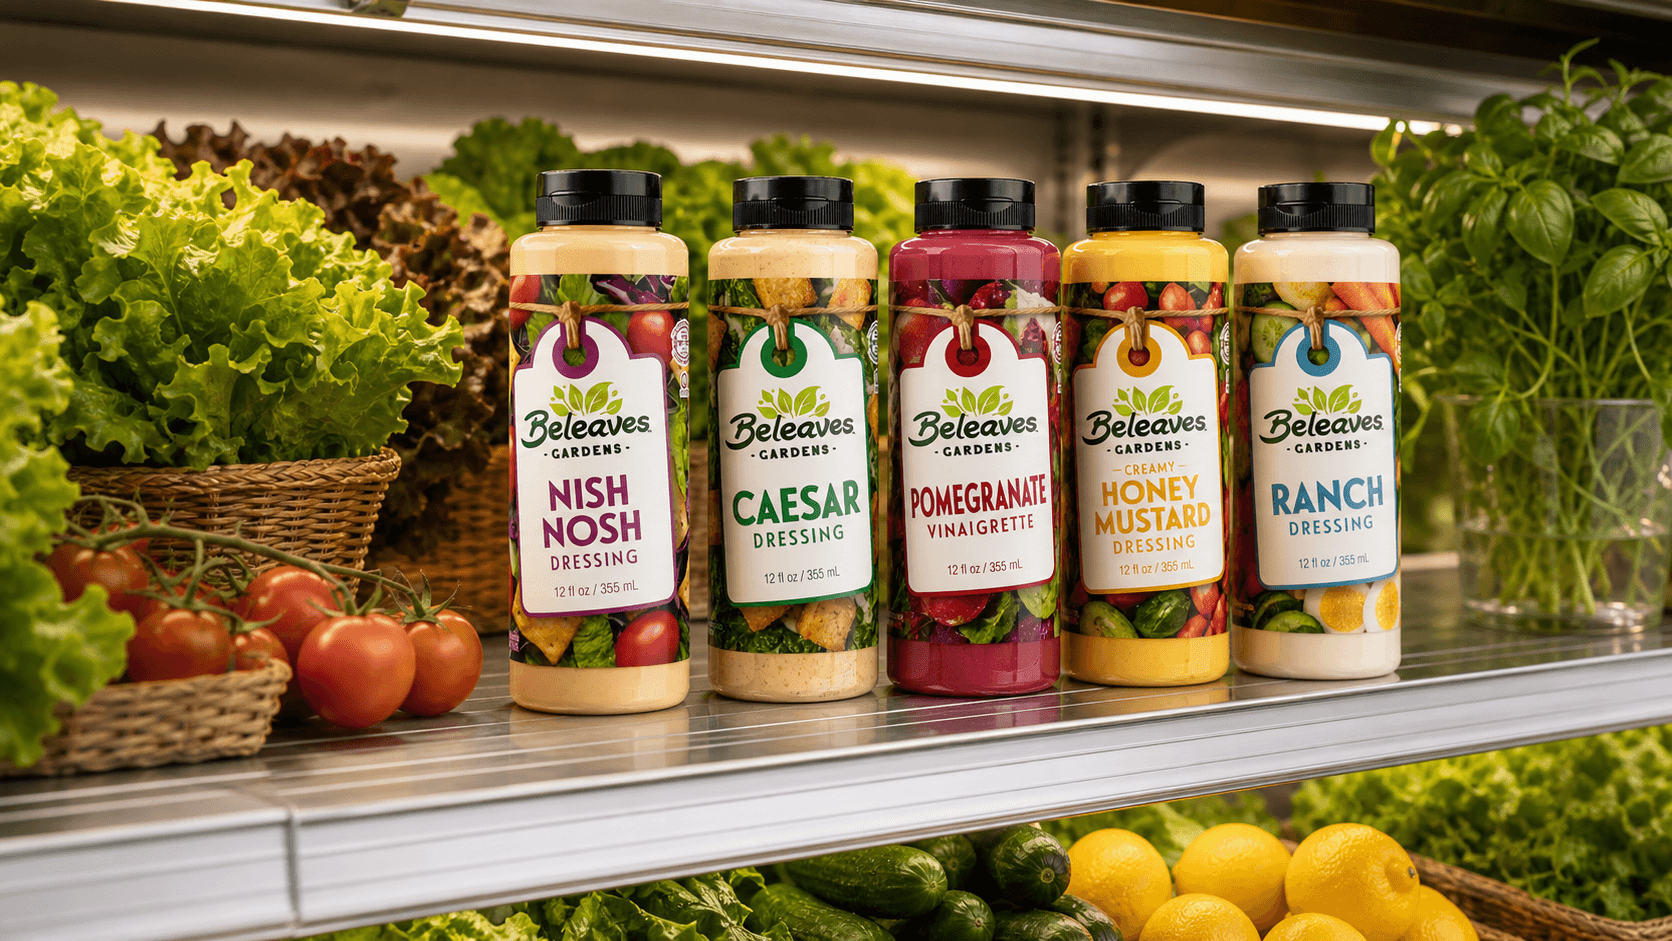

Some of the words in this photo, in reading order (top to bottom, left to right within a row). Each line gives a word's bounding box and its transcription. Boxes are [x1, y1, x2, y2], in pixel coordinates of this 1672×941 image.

[521, 409, 650, 449] Beleaves
[725, 413, 853, 450] Beleaves
[908, 411, 1037, 447] Beleaves
[1082, 411, 1206, 445] Beleaves
[1259, 410, 1382, 444] Beleaves
[552, 444, 622, 459] GARDENS
[759, 445, 829, 460] GARDENS
[943, 442, 1012, 456] GARDENS
[1115, 440, 1181, 454] GARDENS
[1295, 439, 1361, 453] GARDENS
[1125, 461, 1174, 475] CREAMY
[549, 474, 629, 511] NISH
[911, 474, 1047, 518] POMEGRANATE
[1102, 474, 1198, 506] HONEY
[1272, 475, 1383, 515] RANCH
[733, 480, 861, 526] CAESAR
[543, 510, 642, 548] NOSH
[927, 514, 1034, 538] VINAIGRETTE
[1095, 503, 1211, 535] MUSTARD
[1289, 515, 1373, 536] DRESSING
[754, 525, 844, 548] DRESSING
[1114, 534, 1195, 554] DRESSING
[551, 549, 638, 570] DRESSING
[948, 565, 958, 575] 12
[961, 564, 967, 574] fl
[970, 565, 980, 574] oz
[990, 561, 1006, 572] 355
[1010, 559, 1023, 570] mL
[1120, 565, 1130, 575] 12
[1133, 564, 1139, 574] fl
[1142, 565, 1152, 573] oz
[1161, 561, 1178, 572] 355
[1181, 559, 1194, 570] mL
[1299, 559, 1309, 569] 12
[1312, 557, 1317, 568] fl
[1320, 559, 1330, 567] oz
[1339, 555, 1355, 566] 355
[1358, 553, 1369, 563] mL
[765, 573, 775, 584] 12
[778, 572, 784, 583] fl
[787, 573, 798, 582] oz
[807, 569, 824, 580] 355
[827, 566, 840, 578] mL
[555, 586, 565, 597] 12
[568, 585, 575, 596] fl
[578, 586, 590, 595] oz
[600, 582, 620, 594] 355
[624, 580, 638, 591] mL
